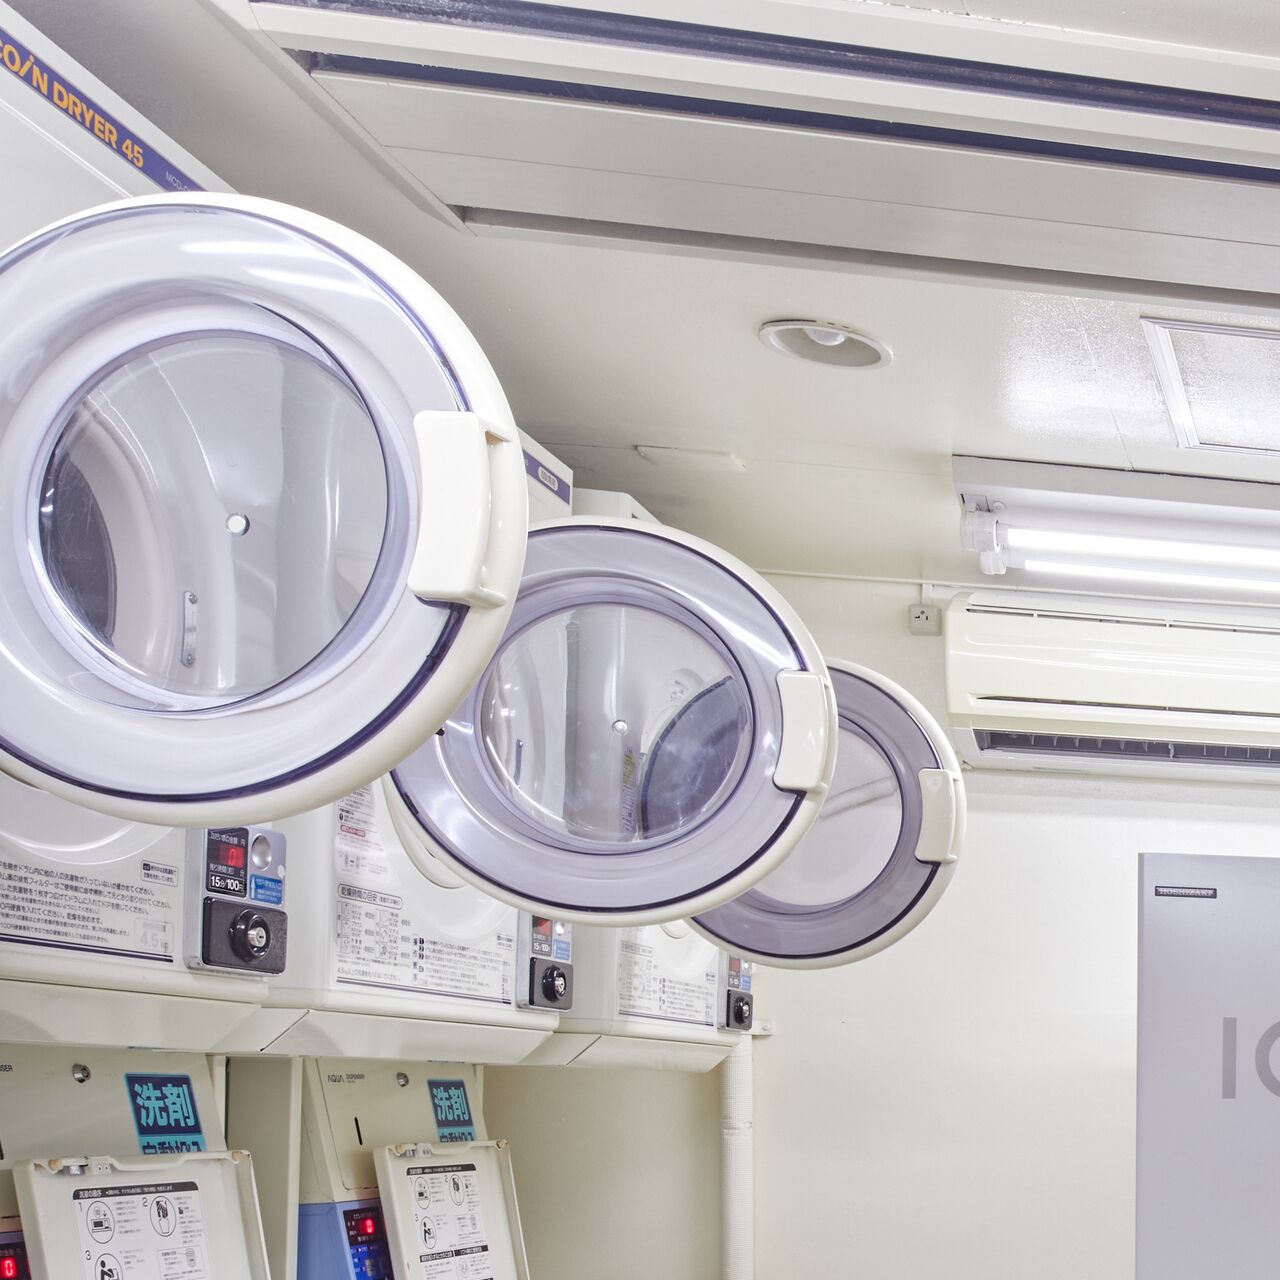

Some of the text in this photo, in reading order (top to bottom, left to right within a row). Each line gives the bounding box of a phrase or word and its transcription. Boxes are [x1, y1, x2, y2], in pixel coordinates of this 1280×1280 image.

[53, 81, 117, 149] DRYER
[122, 139, 144, 167] 45
[134, 1083, 195, 1127] 洗剤
[433, 1087, 469, 1120] 洗剤
[142, 1197, 148, 1207] 2
[85, 1250, 91, 1260] 3
[5, 1260, 14, 1276] 0
